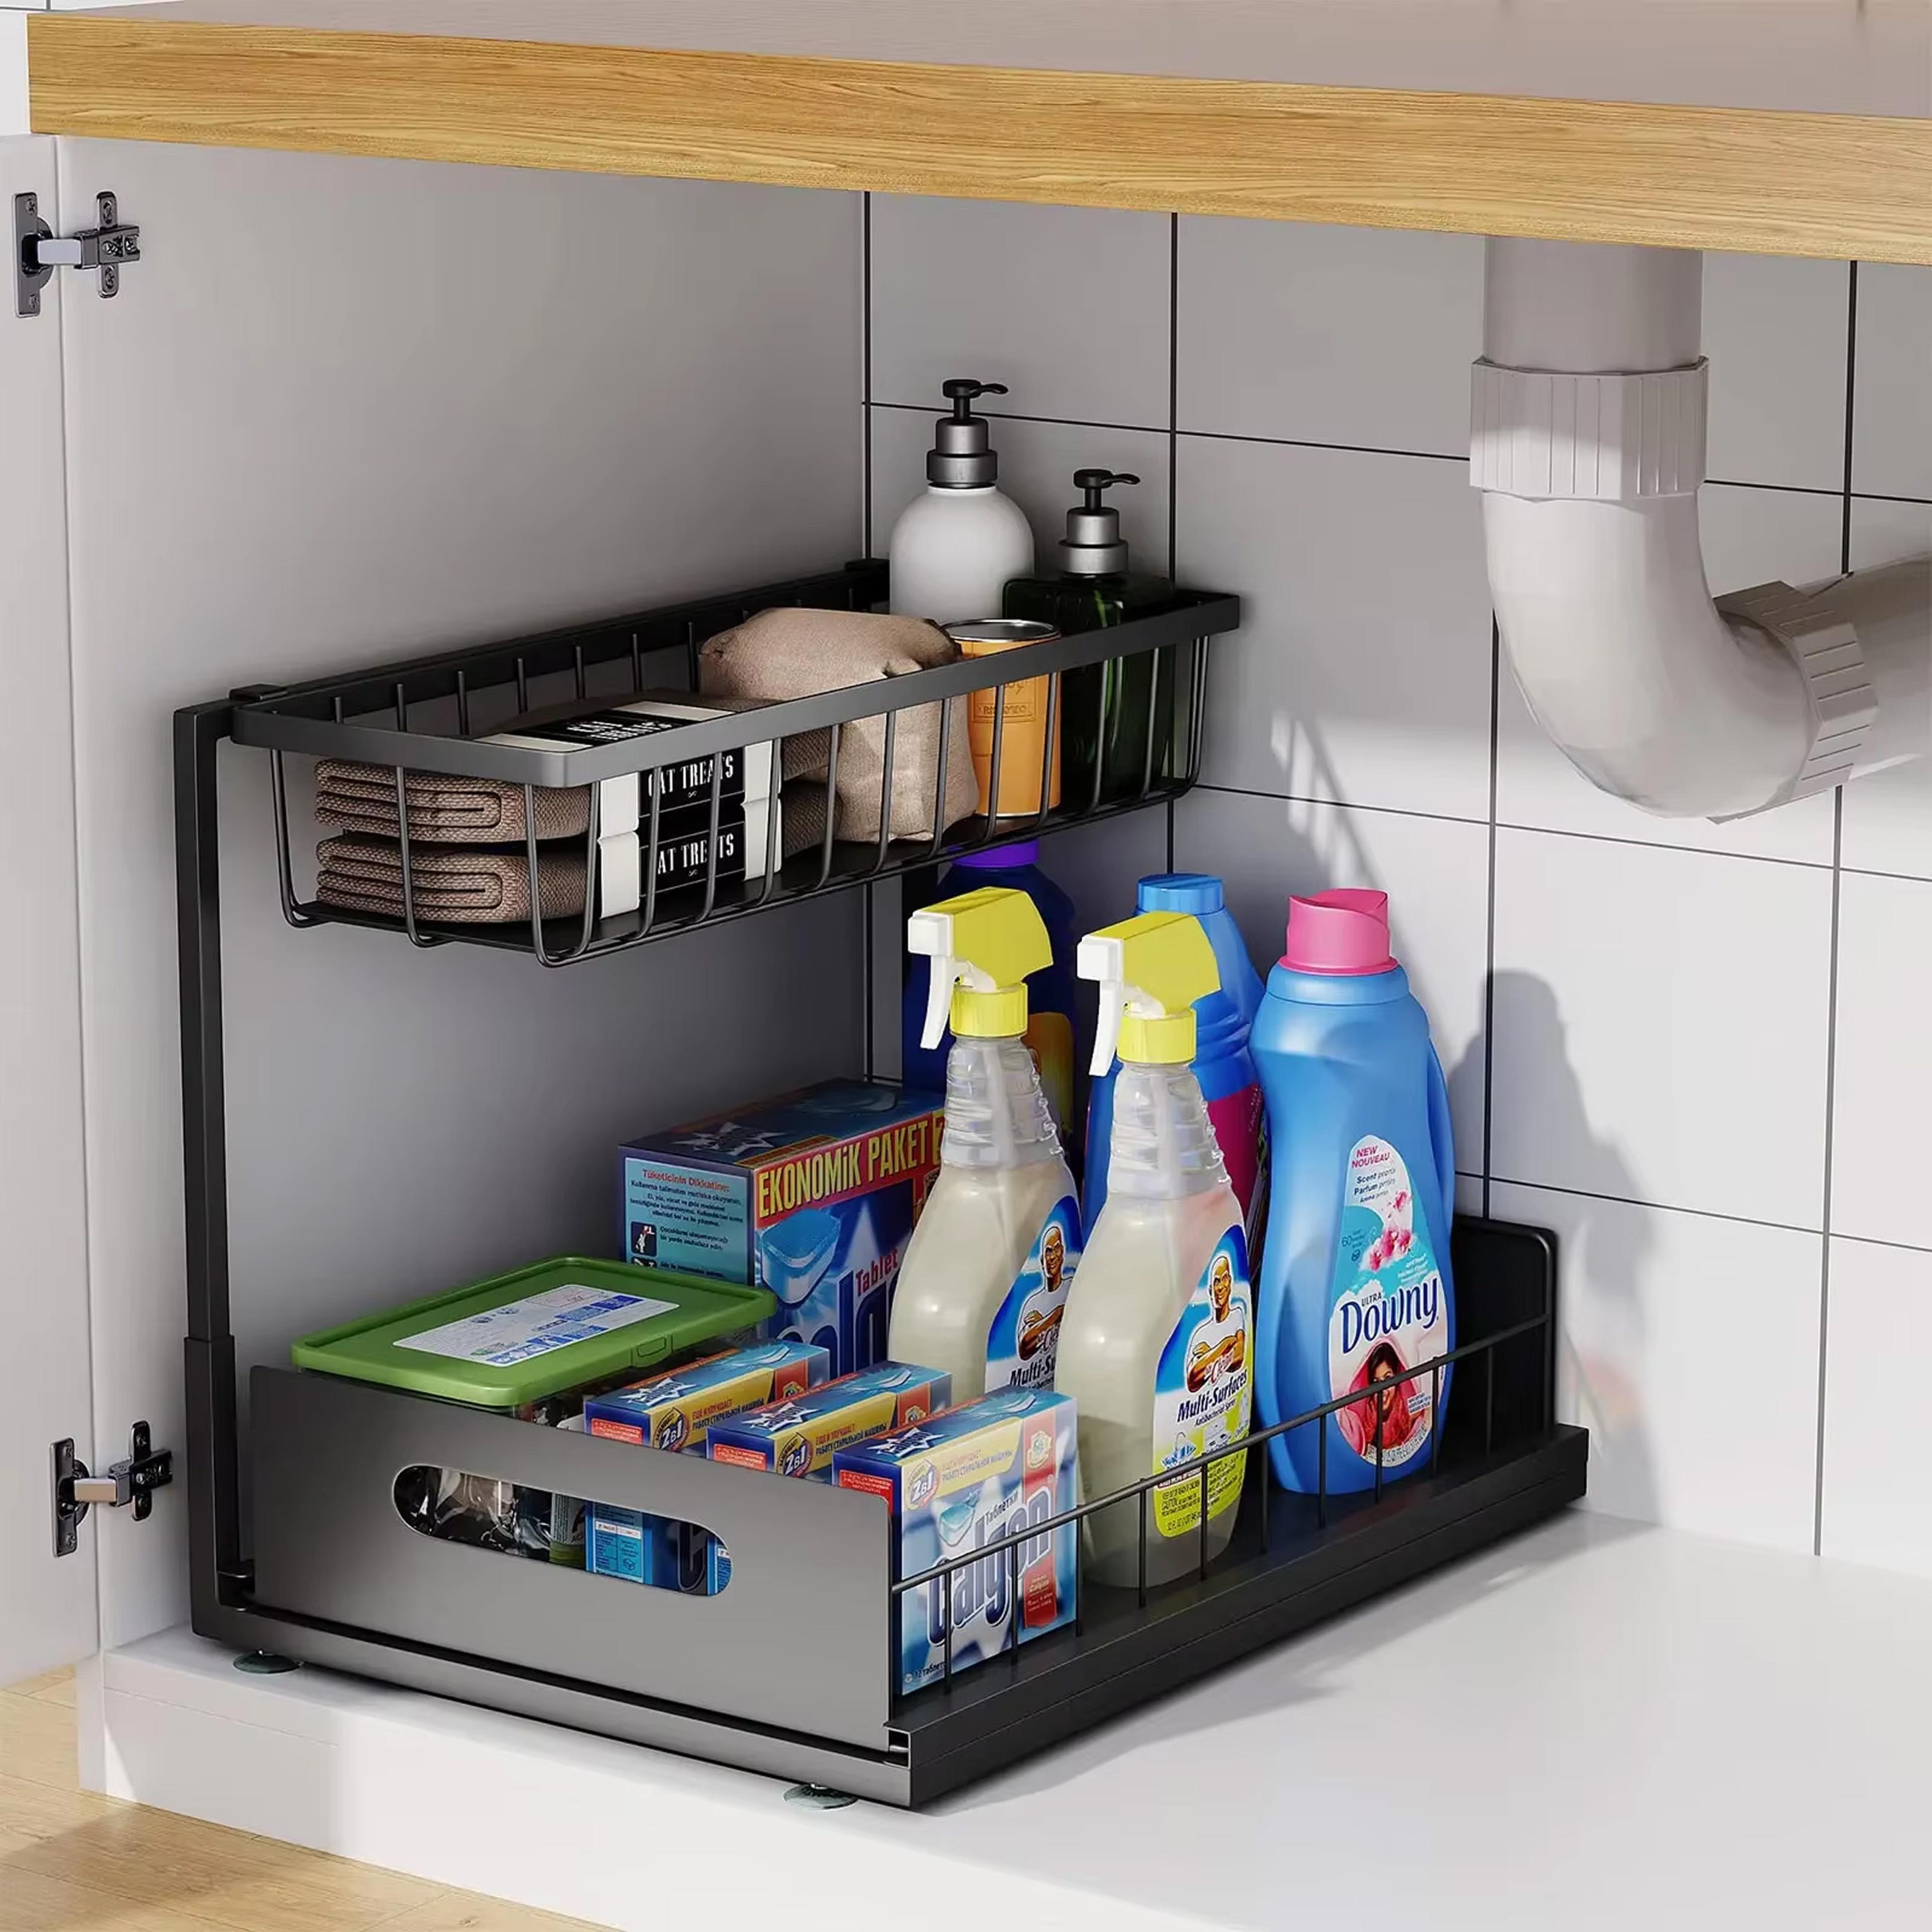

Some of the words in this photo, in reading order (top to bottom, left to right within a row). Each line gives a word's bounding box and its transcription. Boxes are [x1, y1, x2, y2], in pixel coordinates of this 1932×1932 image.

[658, 847, 676, 875] AT
[681, 833, 734, 868] TRETS
[868, 1120, 928, 1182] PAKET
[1352, 1152, 1390, 1168] NOUVEAU
[1356, 1146, 1378, 1158] NEW
[856, 1247, 898, 1294] Tablet
[1340, 1278, 1437, 1353] Downy
[1361, 1292, 1382, 1307] ULTRA
[1177, 1369, 1247, 1422] Multi-Surfaces
[985, 1491, 1018, 1525] Таблетки
